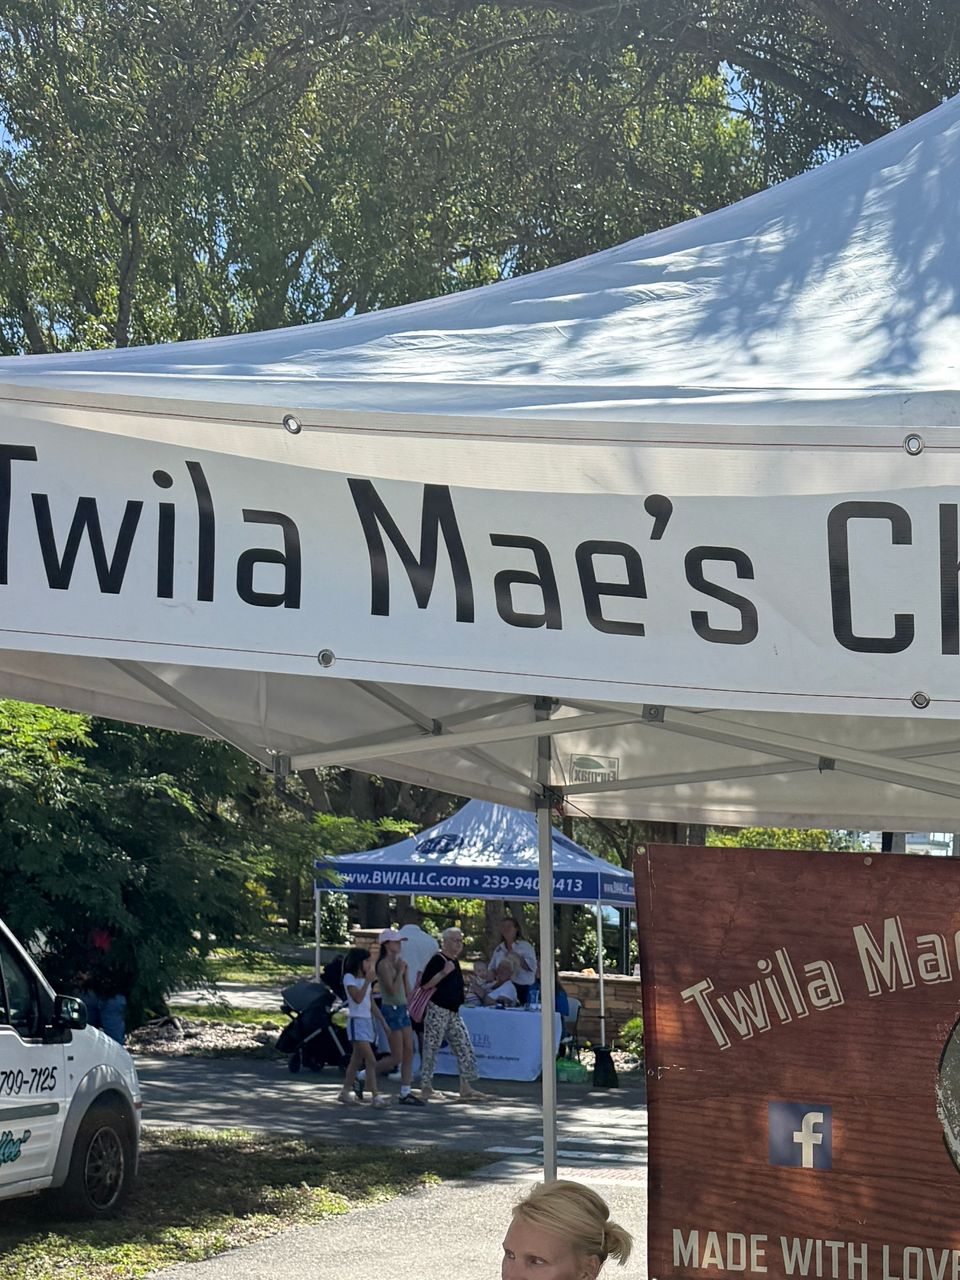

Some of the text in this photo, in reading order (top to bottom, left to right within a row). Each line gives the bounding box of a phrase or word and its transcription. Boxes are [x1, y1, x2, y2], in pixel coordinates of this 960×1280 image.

[0, 444, 301, 609] Twila
[347, 478, 759, 646] Mae's
[681, 946, 845, 1051] Twila
[672, 1228, 768, 1273] MADE
[780, 1235, 869, 1280] WITH
